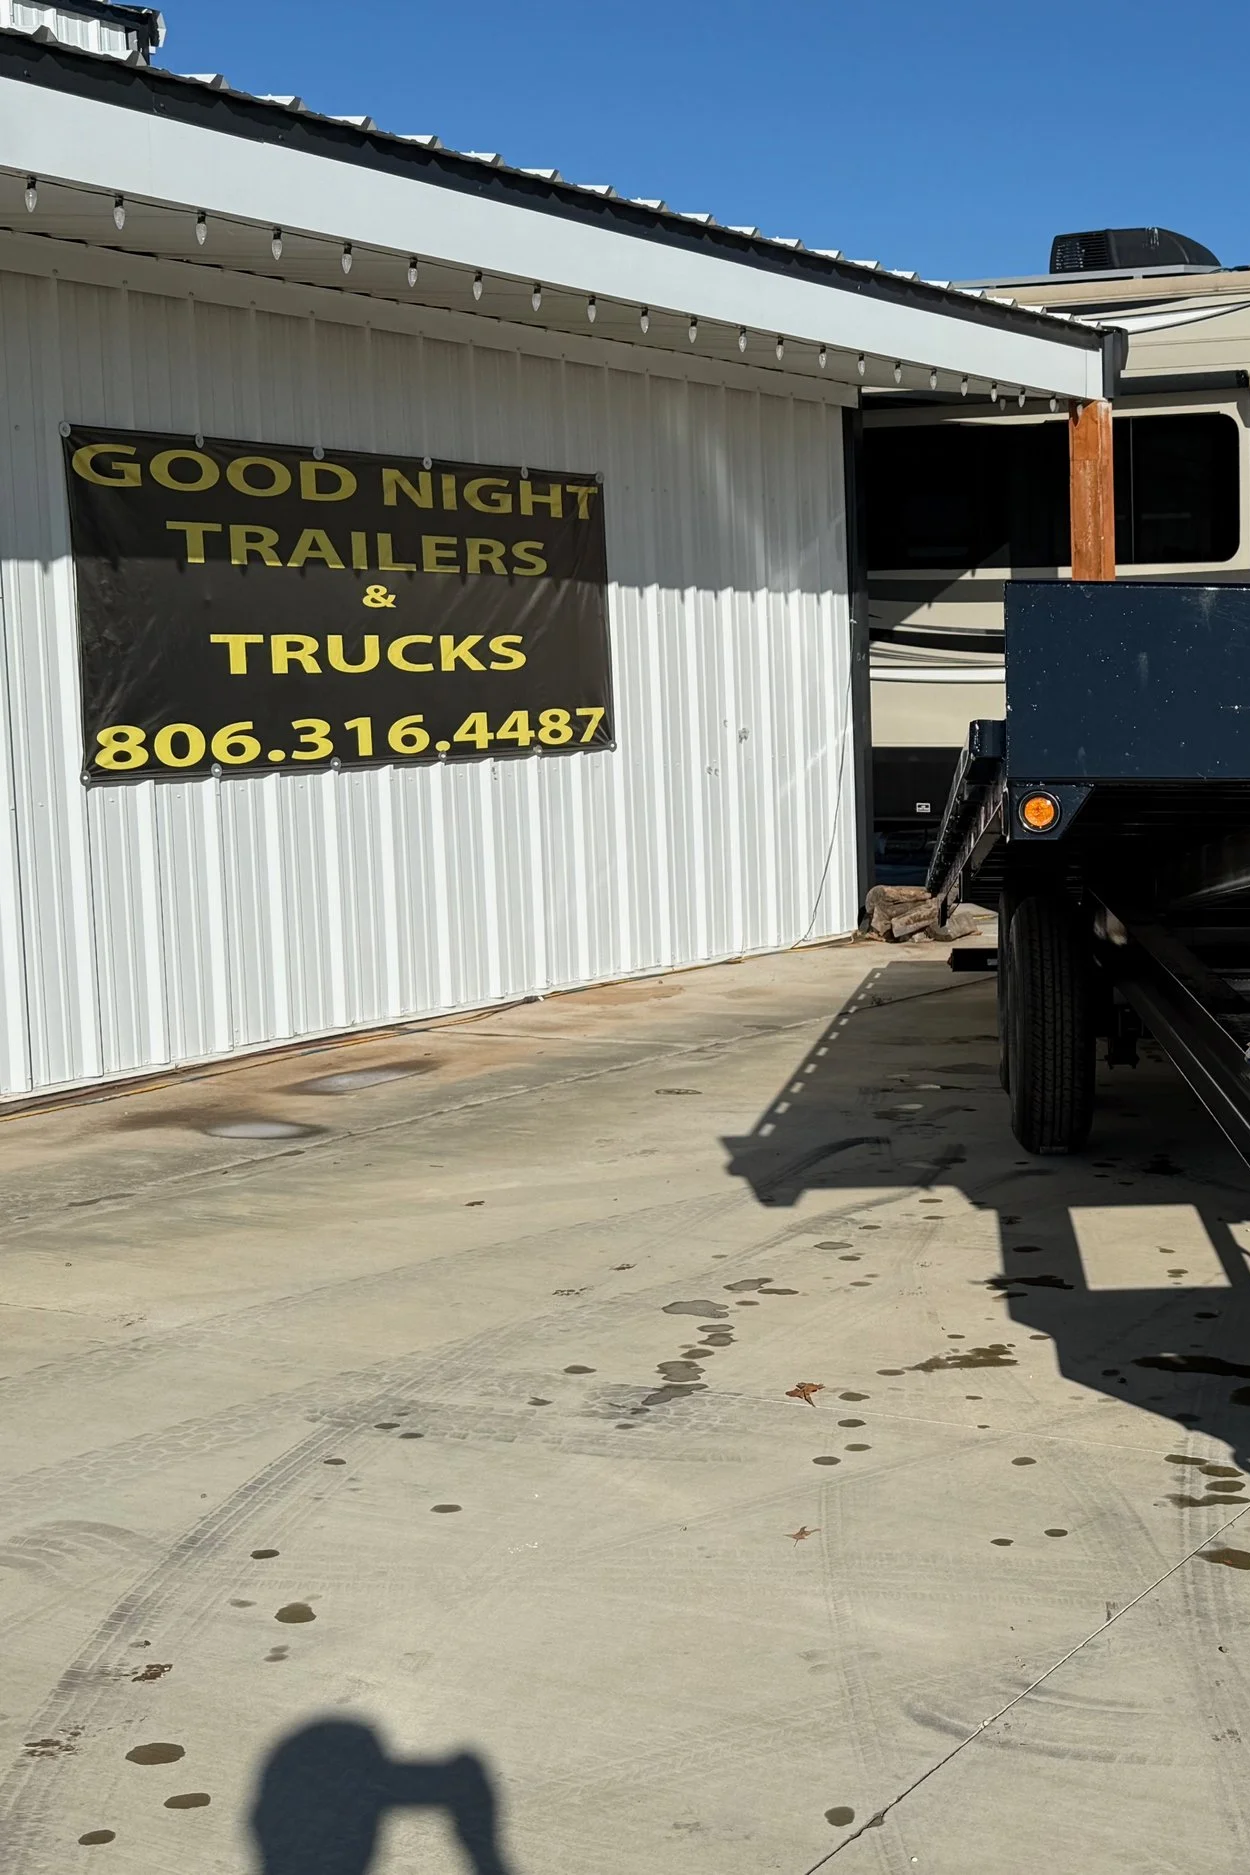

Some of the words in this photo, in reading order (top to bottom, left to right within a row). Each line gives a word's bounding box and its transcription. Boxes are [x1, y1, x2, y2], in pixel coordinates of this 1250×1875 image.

[71, 443, 358, 502] GOOD
[381, 468, 599, 520] NIGHT
[165, 520, 549, 577] TRAILERS
[361, 584, 397, 608] &
[209, 634, 528, 675] TRUCKS
[94, 706, 606, 771] 806.316.4487
